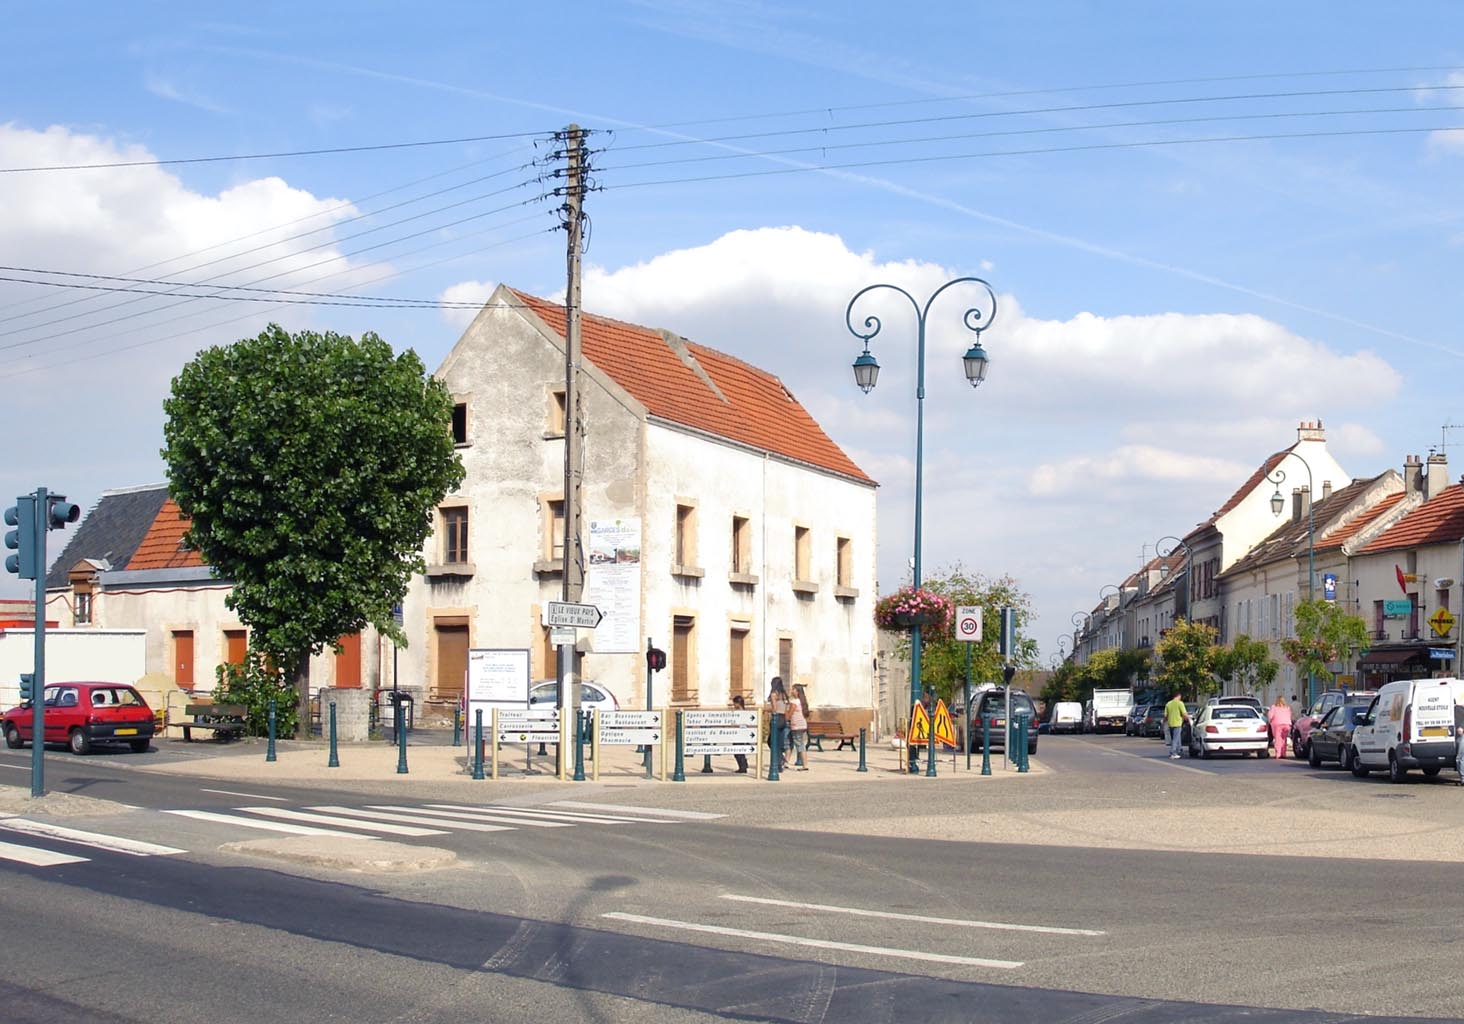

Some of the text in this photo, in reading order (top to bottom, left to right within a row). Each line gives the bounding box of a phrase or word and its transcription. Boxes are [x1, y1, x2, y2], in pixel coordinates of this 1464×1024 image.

[558, 606, 594, 617] LE VIEUX PAYS
[963, 622, 974, 630] 30
